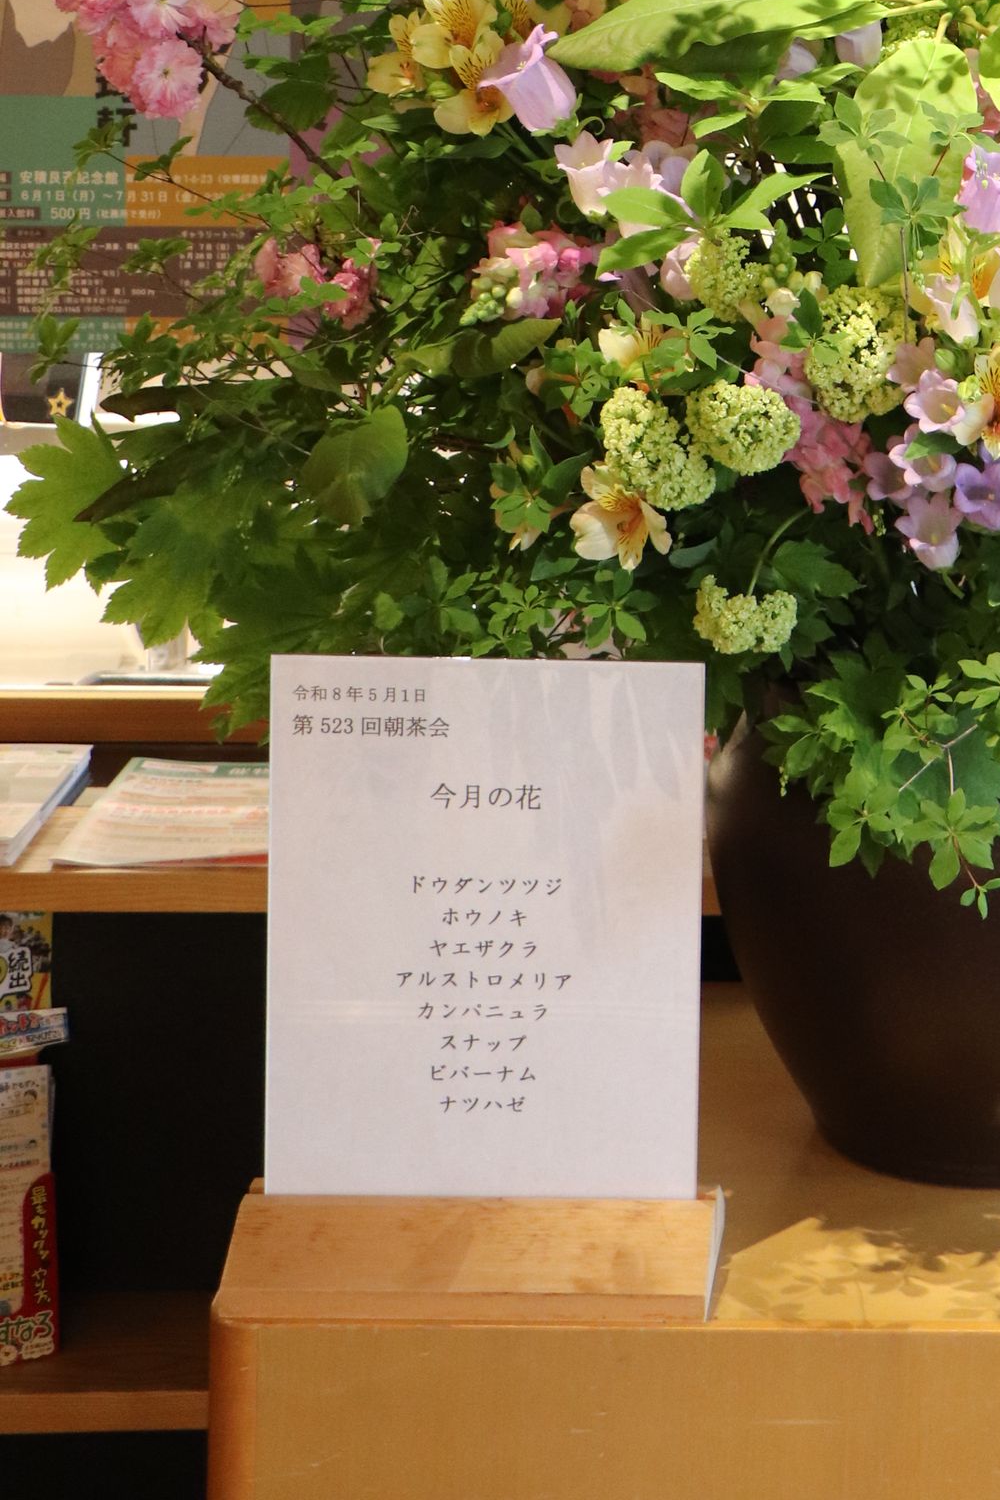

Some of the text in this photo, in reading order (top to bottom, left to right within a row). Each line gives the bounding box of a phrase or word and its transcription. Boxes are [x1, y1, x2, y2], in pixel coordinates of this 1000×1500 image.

[292, 684, 426, 703] 令和8年5月1日
[292, 713, 450, 738] 第523回朝茶会
[429, 782, 543, 811] 今月の花
[412, 875, 562, 896] ドウダンツツジ
[441, 907, 527, 928] ホウノキ
[429, 939, 537, 959] ヤエザクラ
[7, 950, 30, 990] 続出
[396, 970, 572, 991] アルストロメリア
[417, 1001, 548, 1021] カンパニュラ
[440, 1033, 528, 1053] スナップ
[431, 1064, 536, 1083] ビバーナム
[439, 1095, 526, 1114] ナツハゼ
